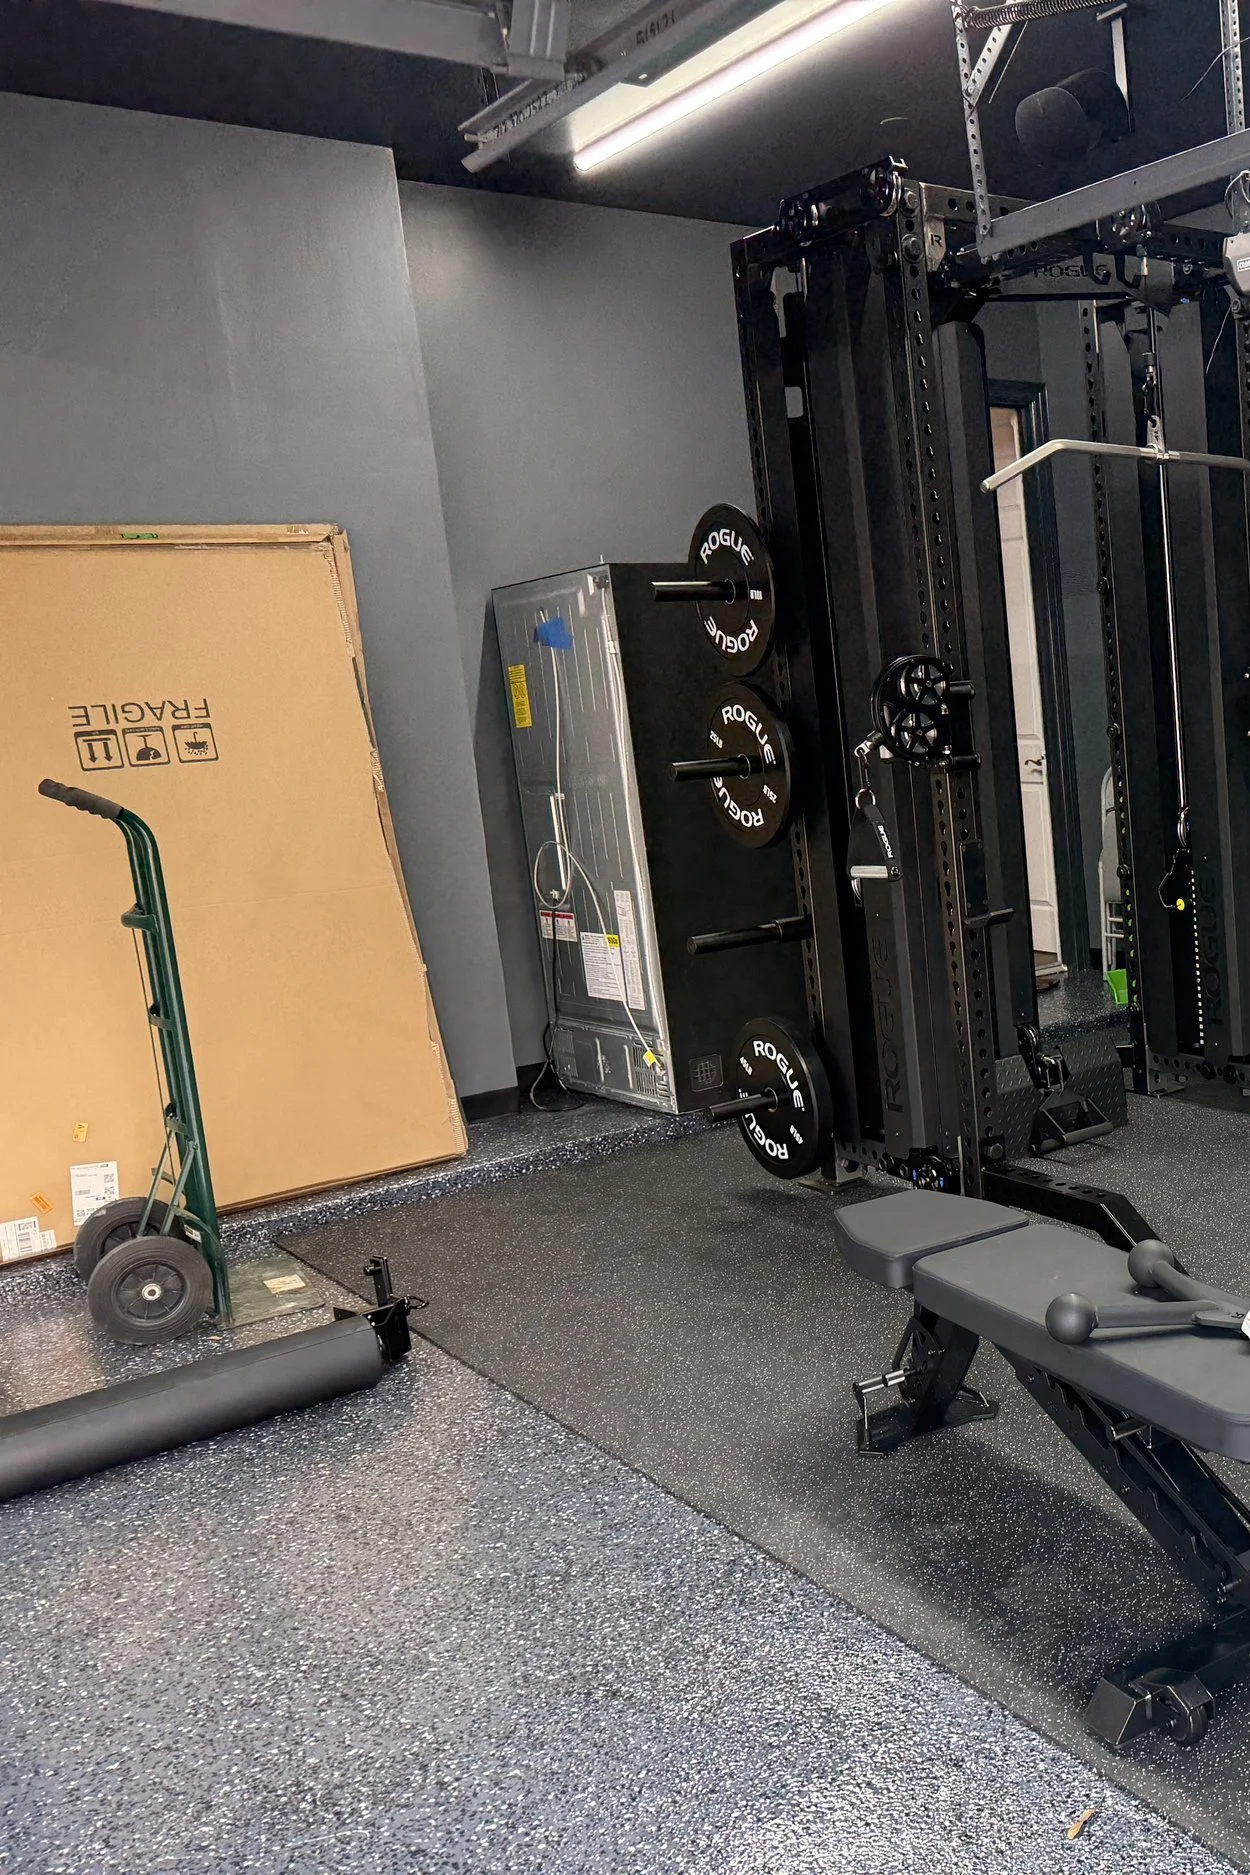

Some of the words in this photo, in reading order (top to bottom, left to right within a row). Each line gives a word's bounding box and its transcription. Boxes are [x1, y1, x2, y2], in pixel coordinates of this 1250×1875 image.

[700, 528, 753, 566] ROGUE
[704, 616, 758, 653] ROGUE
[68, 698, 211, 727] FRAGILE
[709, 730, 724, 749] 25LB
[721, 704, 775, 764] ROGUE
[763, 784, 778, 803] 25LB
[877, 825, 893, 858] ROGUE
[753, 1040, 804, 1110] ROGUE
[739, 1091, 789, 1159] ROGU
